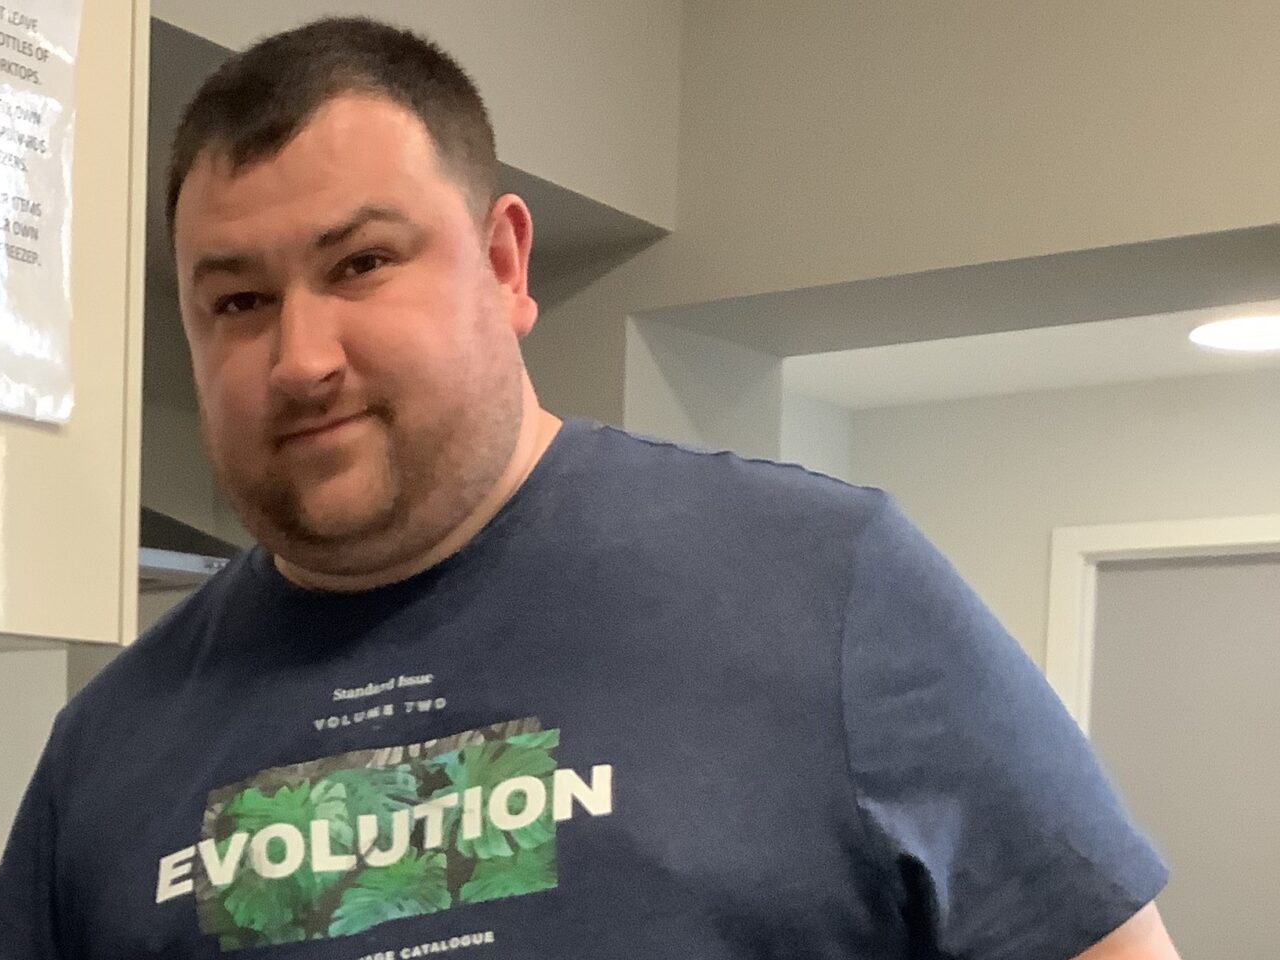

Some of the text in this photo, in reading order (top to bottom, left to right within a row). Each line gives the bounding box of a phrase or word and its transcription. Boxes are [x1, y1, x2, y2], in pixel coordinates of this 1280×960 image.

[8, 11, 38, 32] LEAVE
[35, 47, 49, 62] OF
[12, 220, 39, 241] OWN
[332, 673, 434, 701] Standard Issue
[313, 697, 447, 731] VOLUME TWO
[155, 764, 613, 904] EVOLUTION
[400, 931, 496, 960] CATALOGUE
